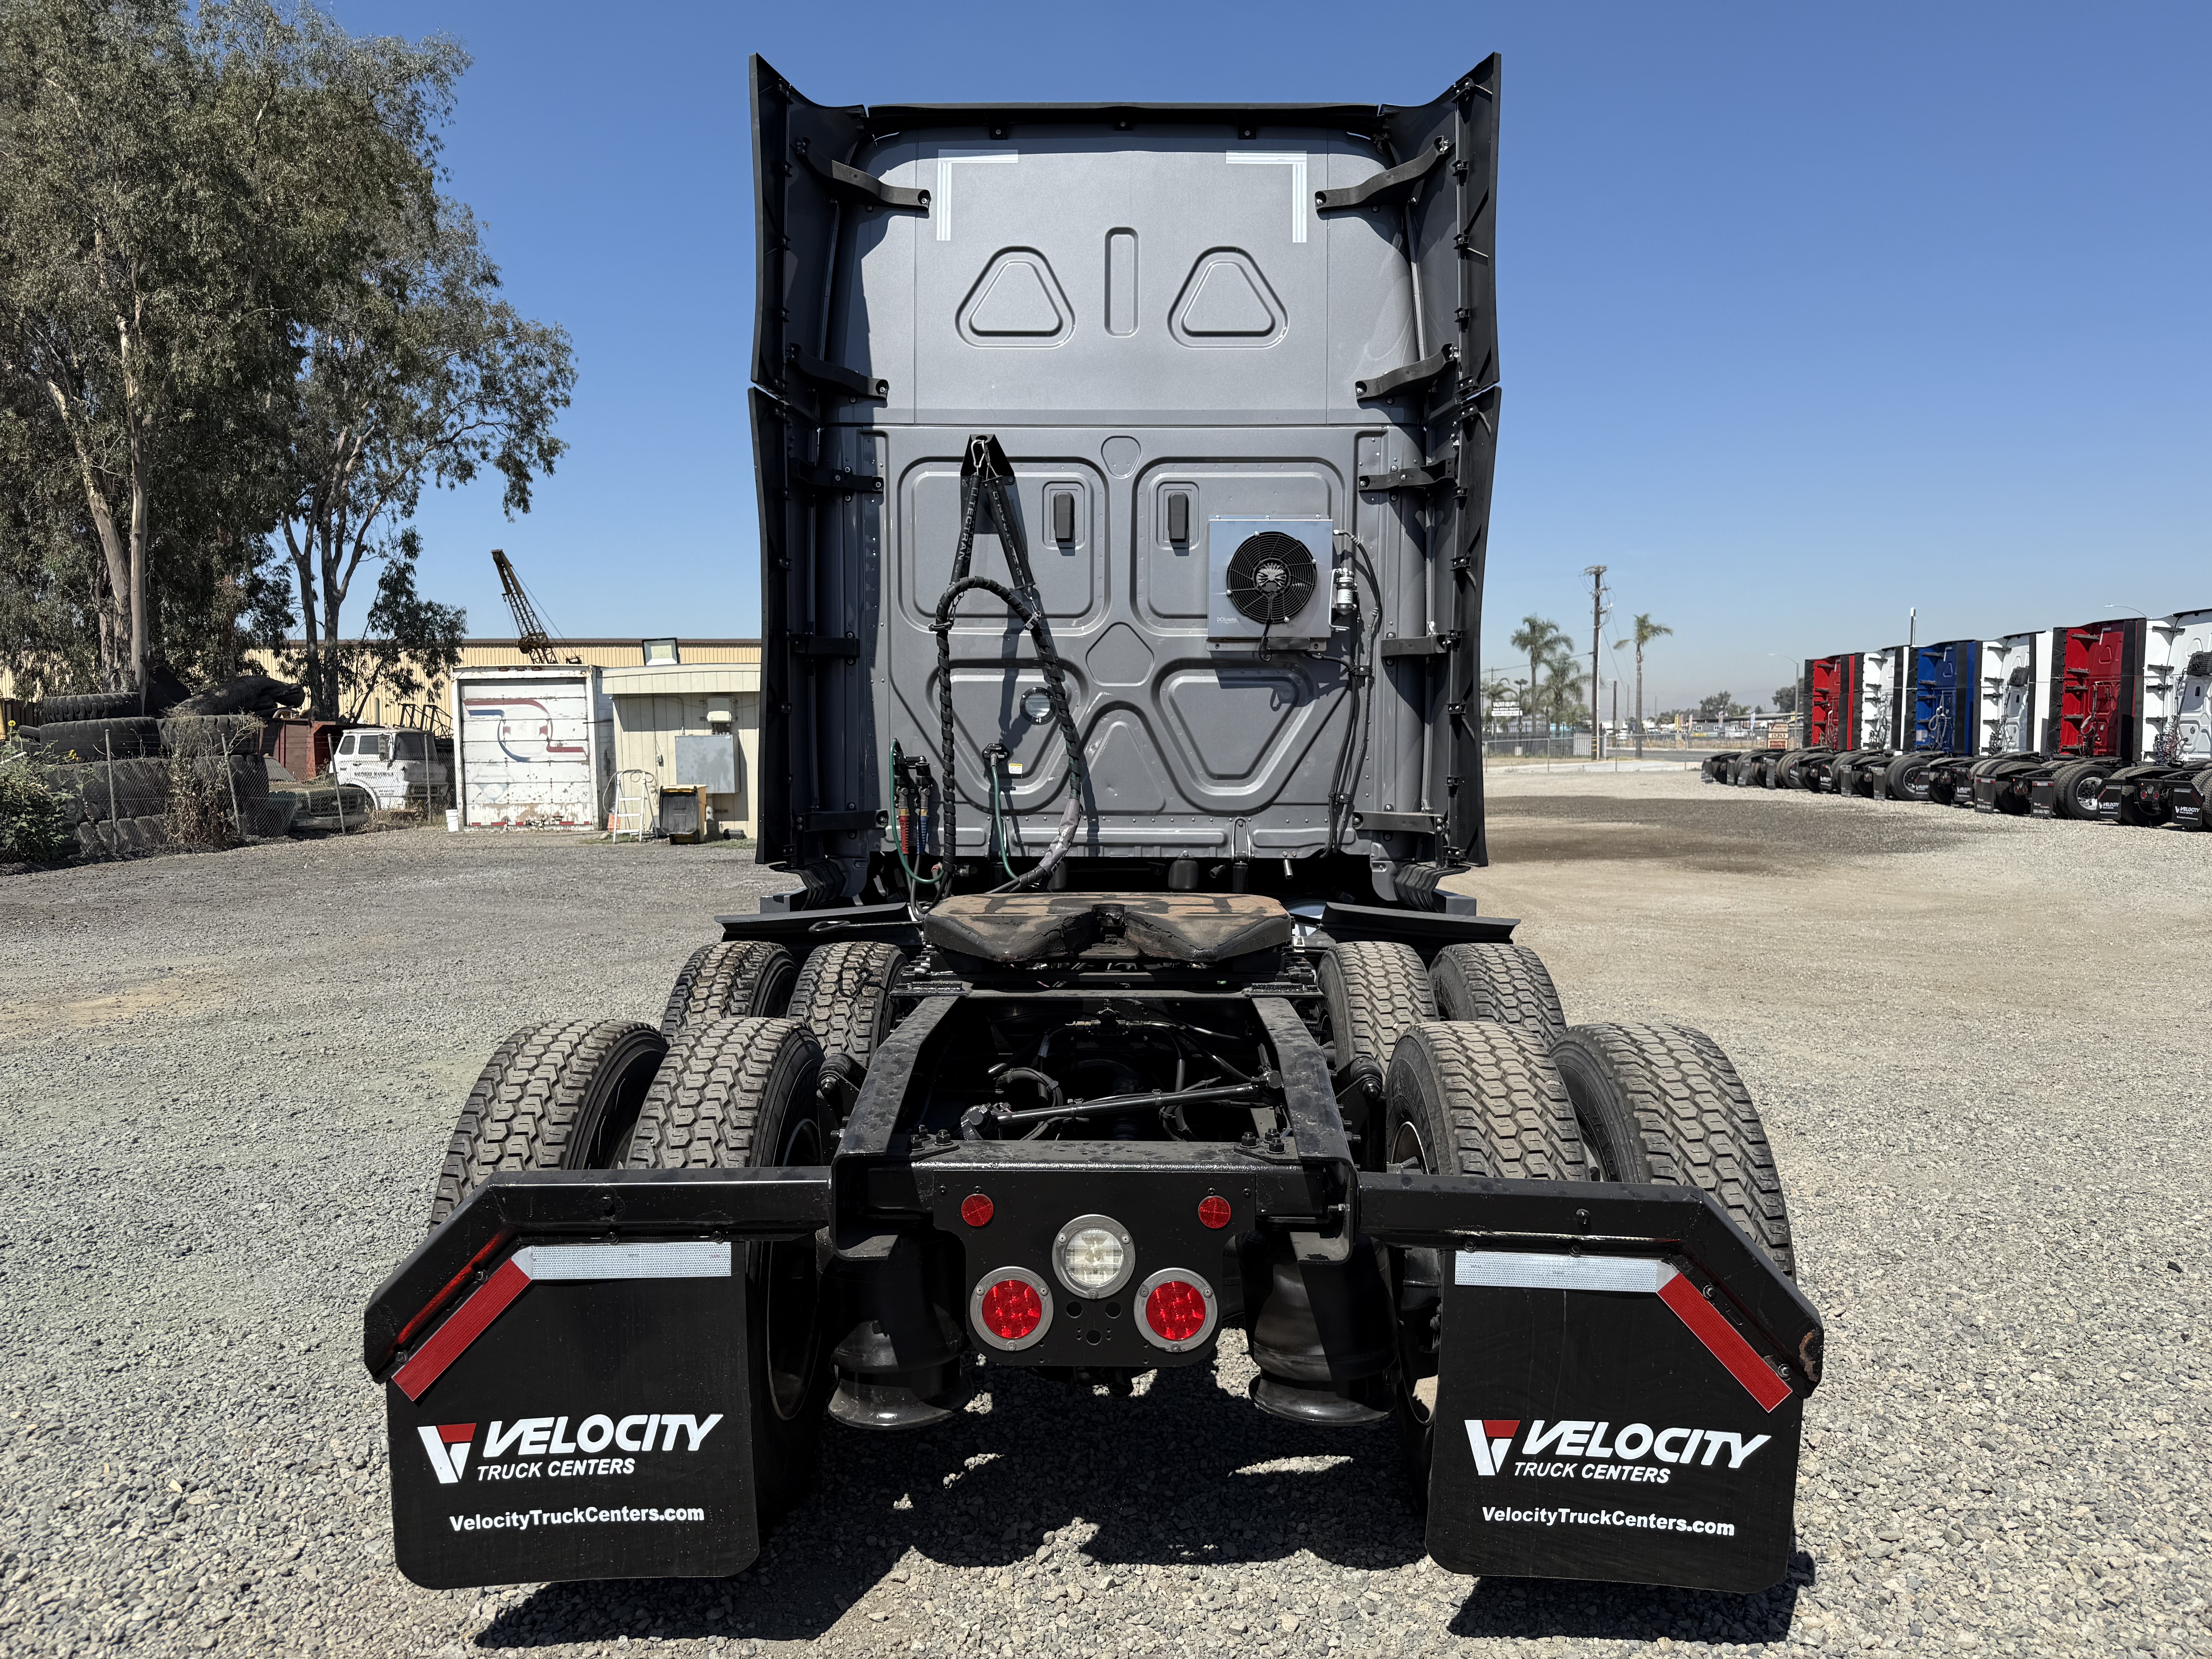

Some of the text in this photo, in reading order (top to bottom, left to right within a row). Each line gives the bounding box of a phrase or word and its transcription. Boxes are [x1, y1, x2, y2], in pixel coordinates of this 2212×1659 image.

[958, 500, 976, 560] TECTRAN
[483, 1414, 724, 1458] VELOCITY
[1522, 1420, 1772, 1468] VELOCITY
[477, 1458, 635, 1481] TRUCK CENTERS
[1515, 1462, 1671, 1484] TRUCK CENTERS
[449, 1506, 704, 1531] VelocityTruckCenters.com
[1482, 1507, 1735, 1536] VelocityTruckCenters.com
